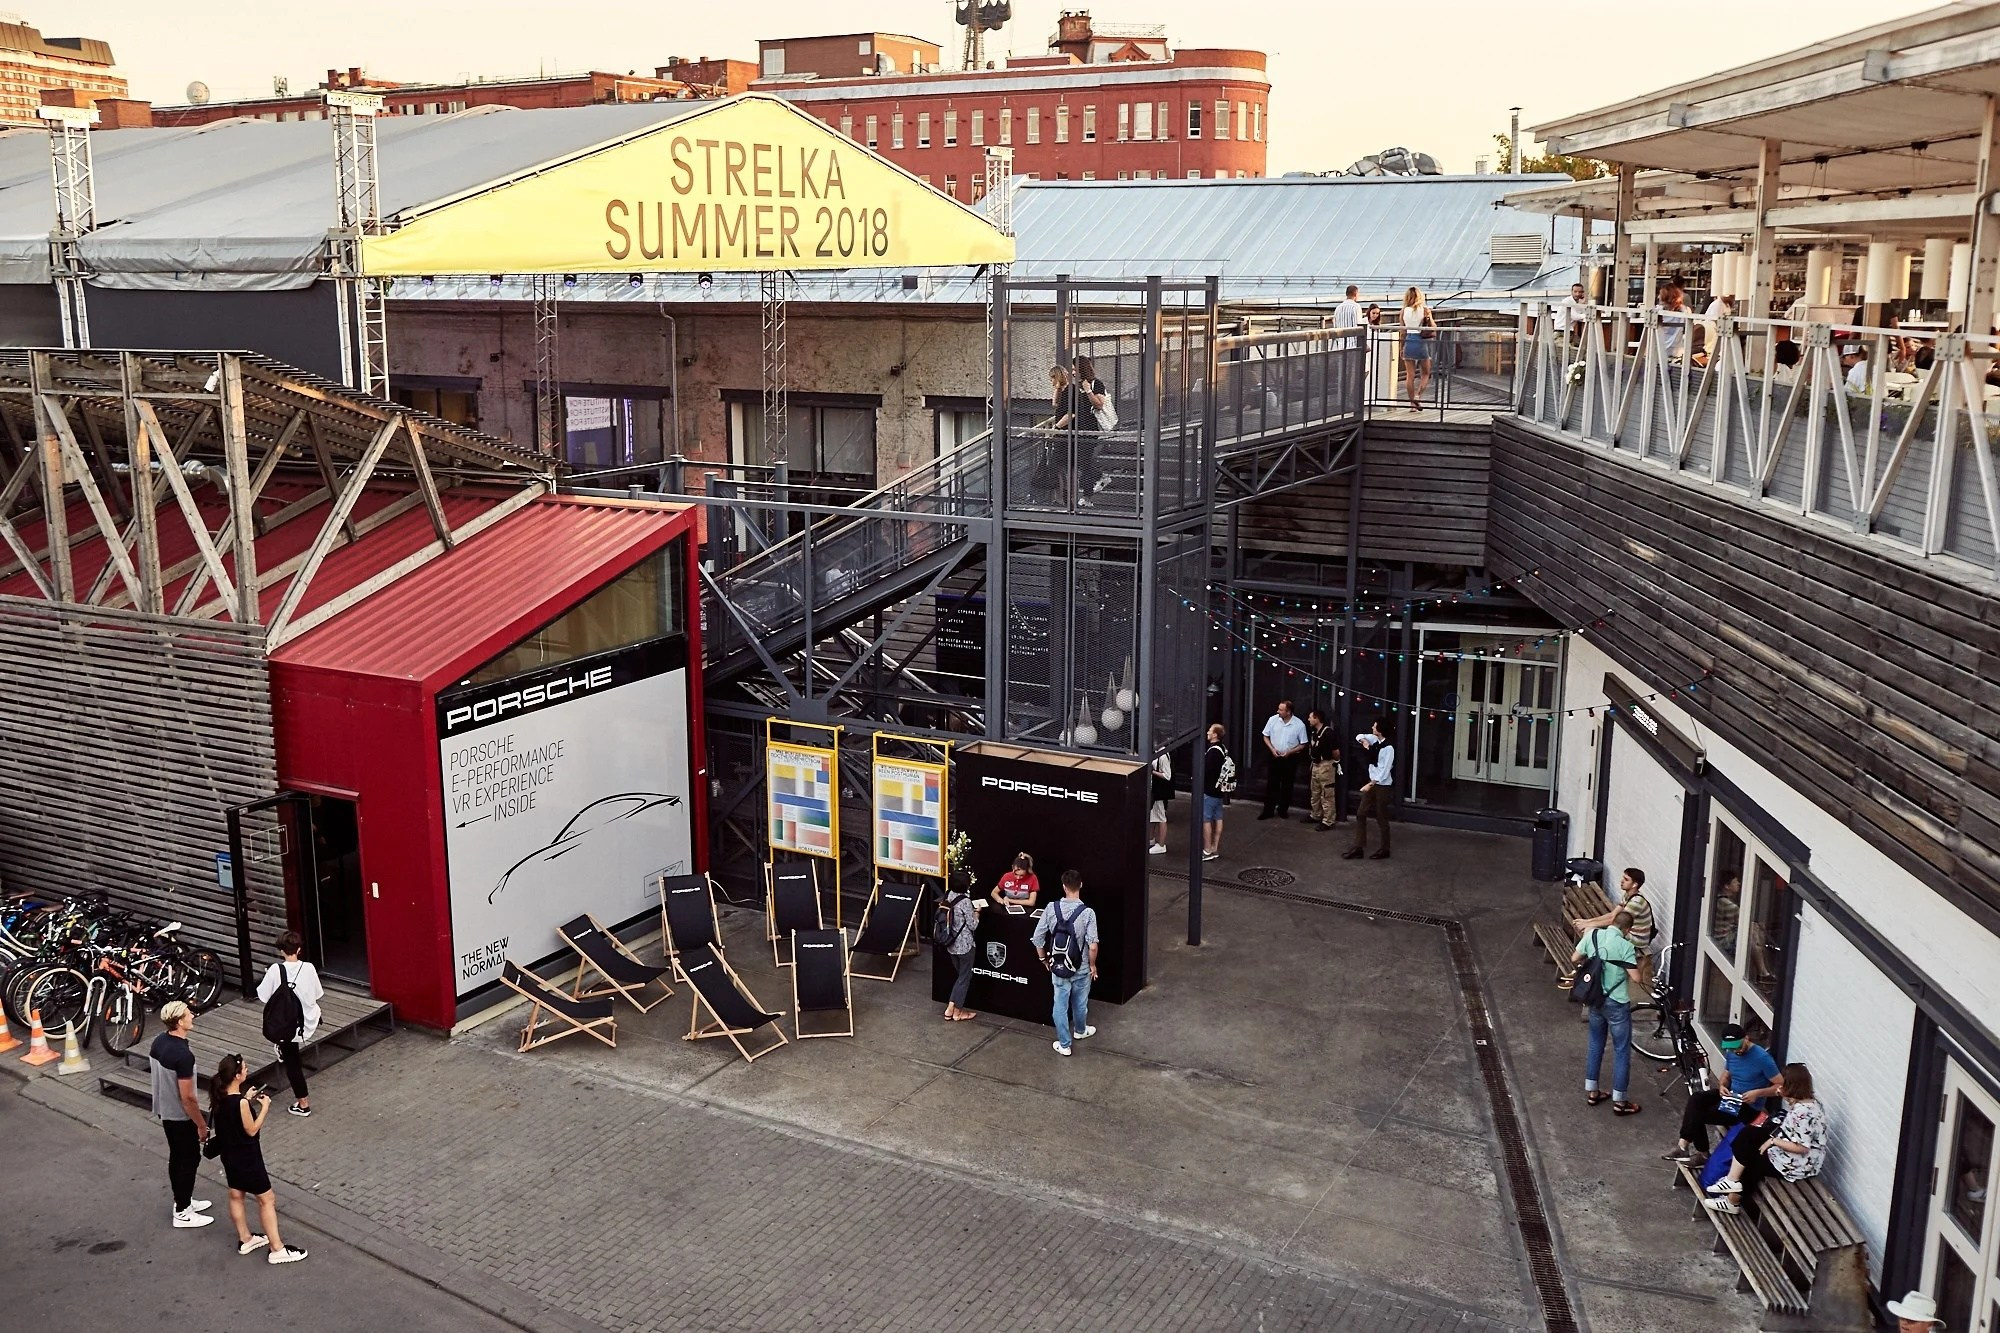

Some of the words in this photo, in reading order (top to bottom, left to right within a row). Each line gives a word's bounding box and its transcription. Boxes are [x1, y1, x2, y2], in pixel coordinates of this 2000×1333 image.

[670, 137, 845, 199] STRELKA
[606, 199, 800, 260] SUMMER
[816, 207, 889, 257] 2018
[447, 666, 612, 730] PORSCHE
[450, 734, 514, 770] PORSCHE
[452, 740, 564, 793] E-PERFORMANCE
[452, 793, 470, 814] VR
[476, 764, 554, 807] EXPERIENCE
[494, 791, 536, 822] INSIDE
[982, 776, 1098, 804] PORSCHE
[461, 948, 482, 966] THE
[486, 936, 509, 956] NEW
[971, 968, 1028, 984] ORSCHE
